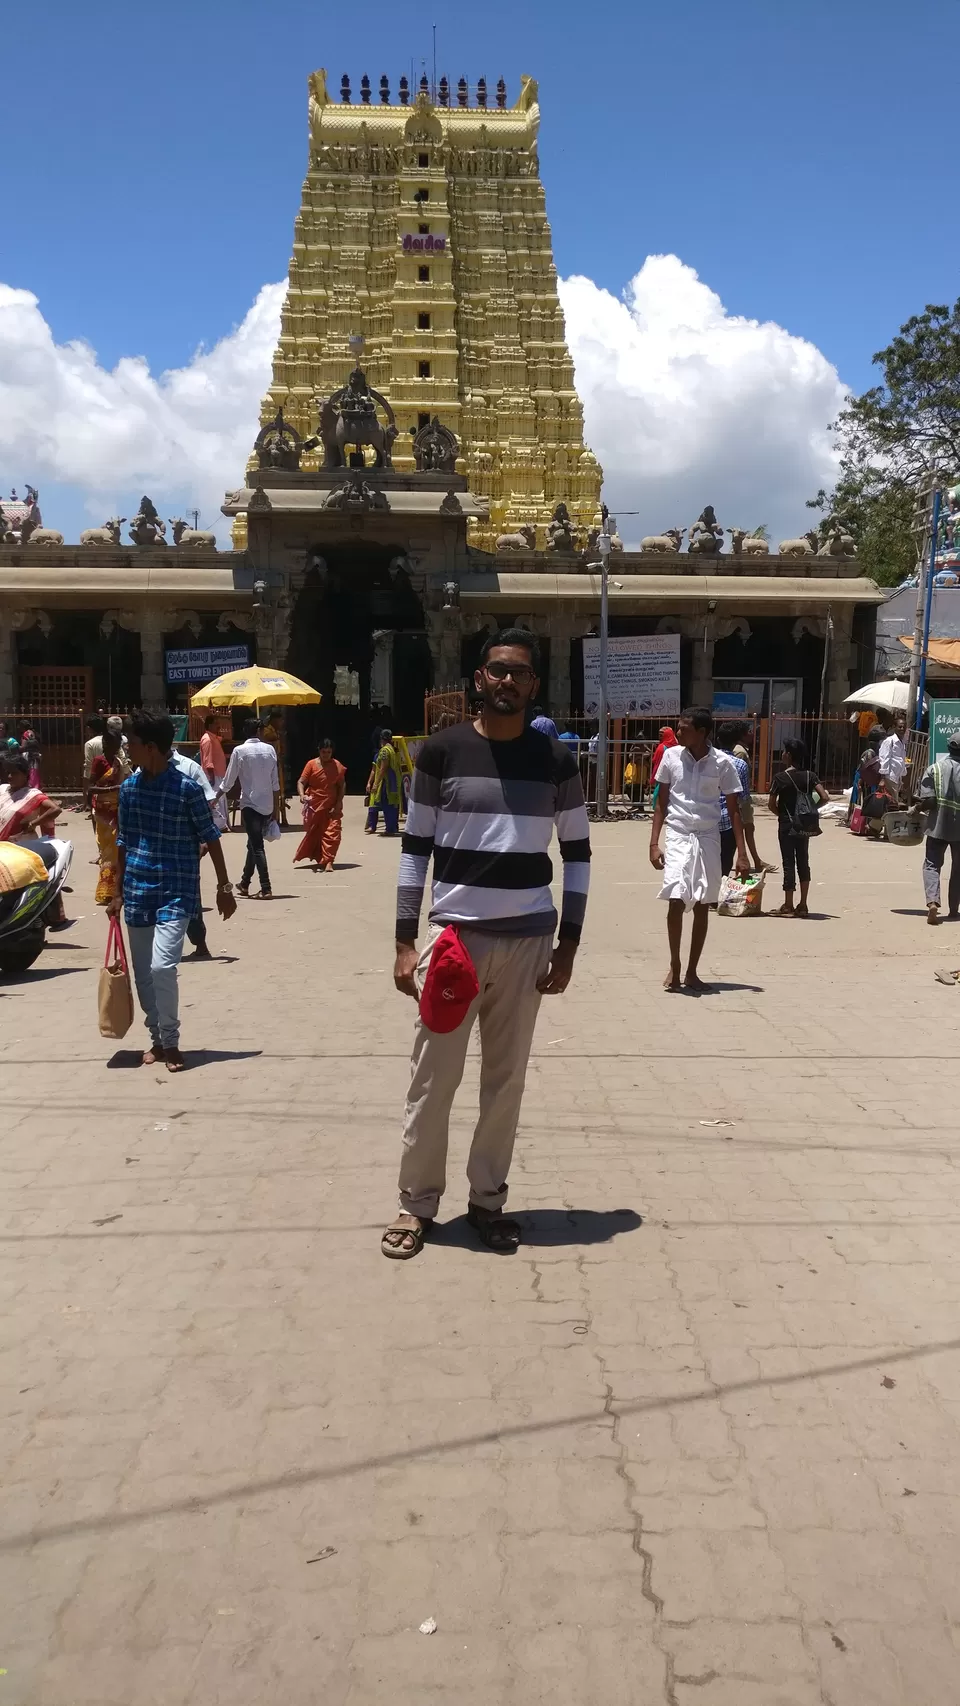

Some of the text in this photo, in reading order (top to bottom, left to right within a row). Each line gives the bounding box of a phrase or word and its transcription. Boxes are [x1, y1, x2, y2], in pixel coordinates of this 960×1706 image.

[645, 641, 673, 650] THINGS
[168, 668, 186, 679] EAST
[187, 667, 212, 678] TOWER
